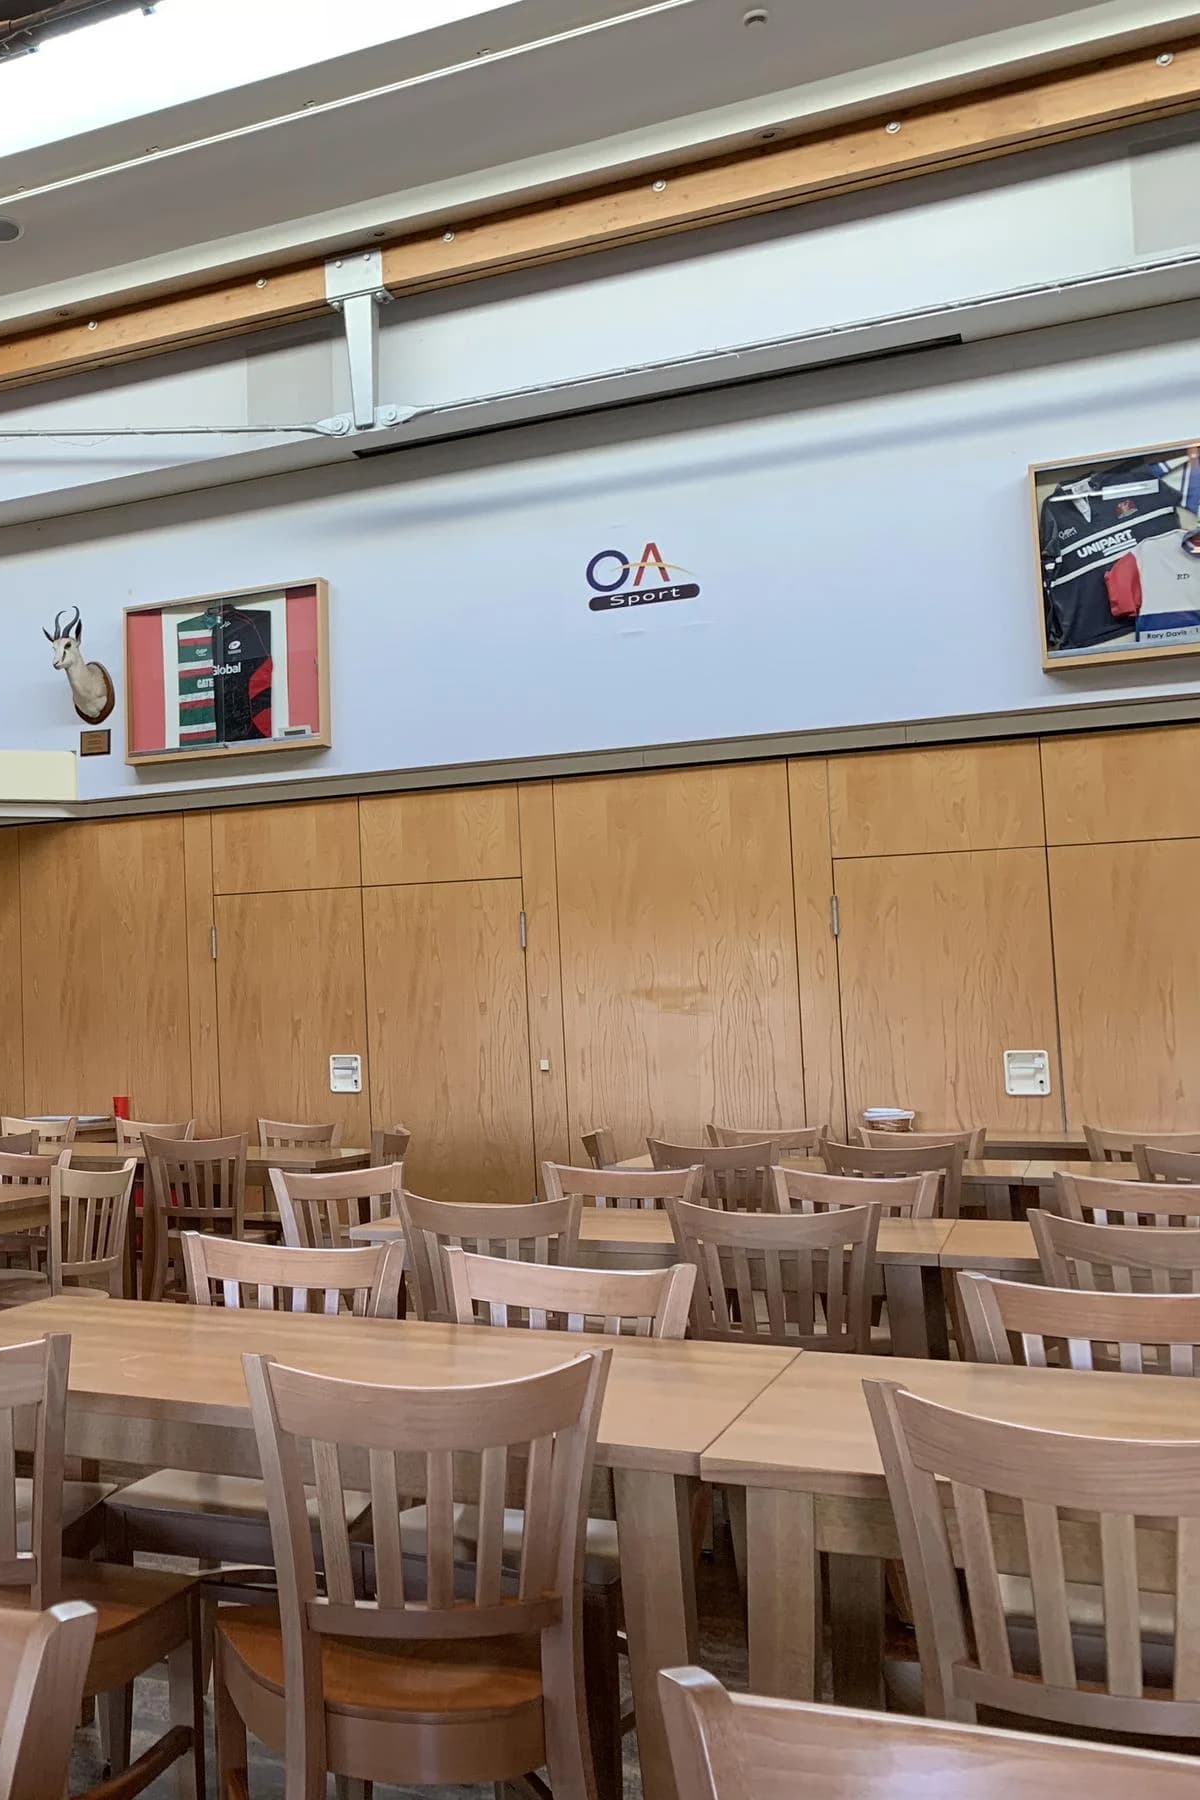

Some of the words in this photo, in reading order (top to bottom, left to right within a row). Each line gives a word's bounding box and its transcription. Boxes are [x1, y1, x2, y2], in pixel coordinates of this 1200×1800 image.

[1077, 529, 1133, 558] UNIPART
[586, 542, 670, 592] OA
[610, 588, 681, 607] Sport
[1146, 630, 1164, 641] Rory
[1166, 628, 1188, 639] Davis
